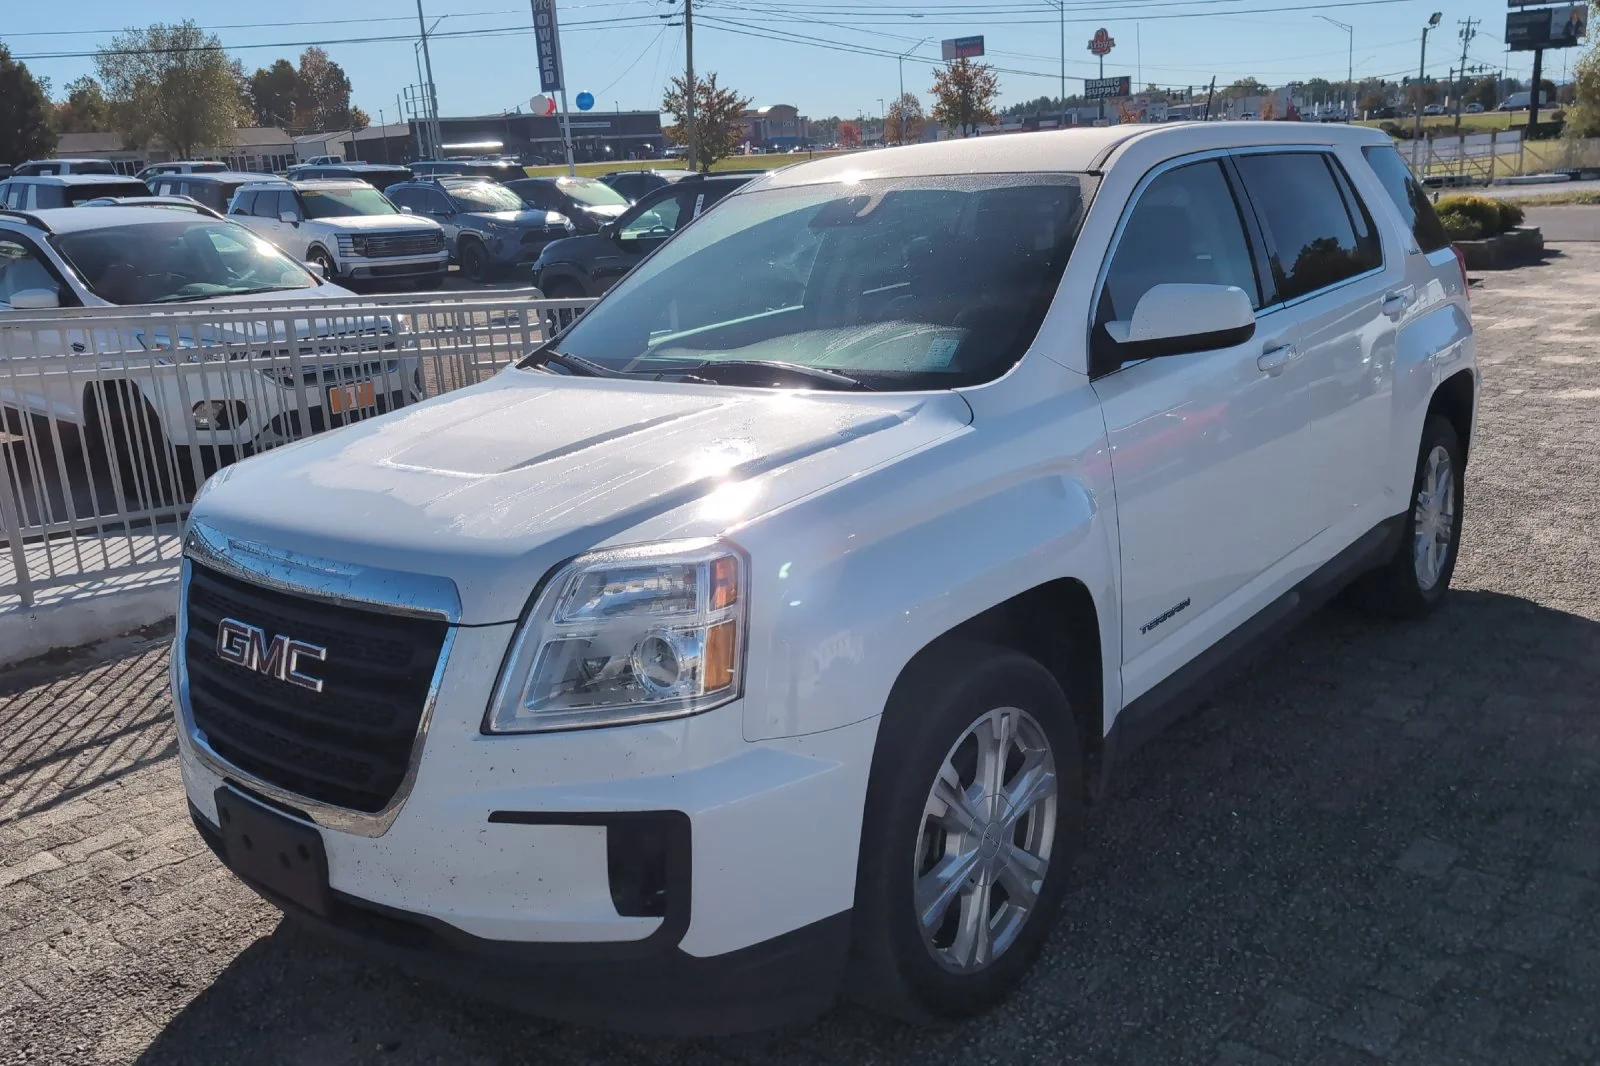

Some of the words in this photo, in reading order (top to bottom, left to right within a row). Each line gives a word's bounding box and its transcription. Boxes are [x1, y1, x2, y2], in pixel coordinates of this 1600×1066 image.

[537, 13, 555, 84] OWNED
[1086, 78, 1120, 89] SIDING
[1086, 86, 1120, 97] SUPPLY
[216, 617, 327, 693] GMC
